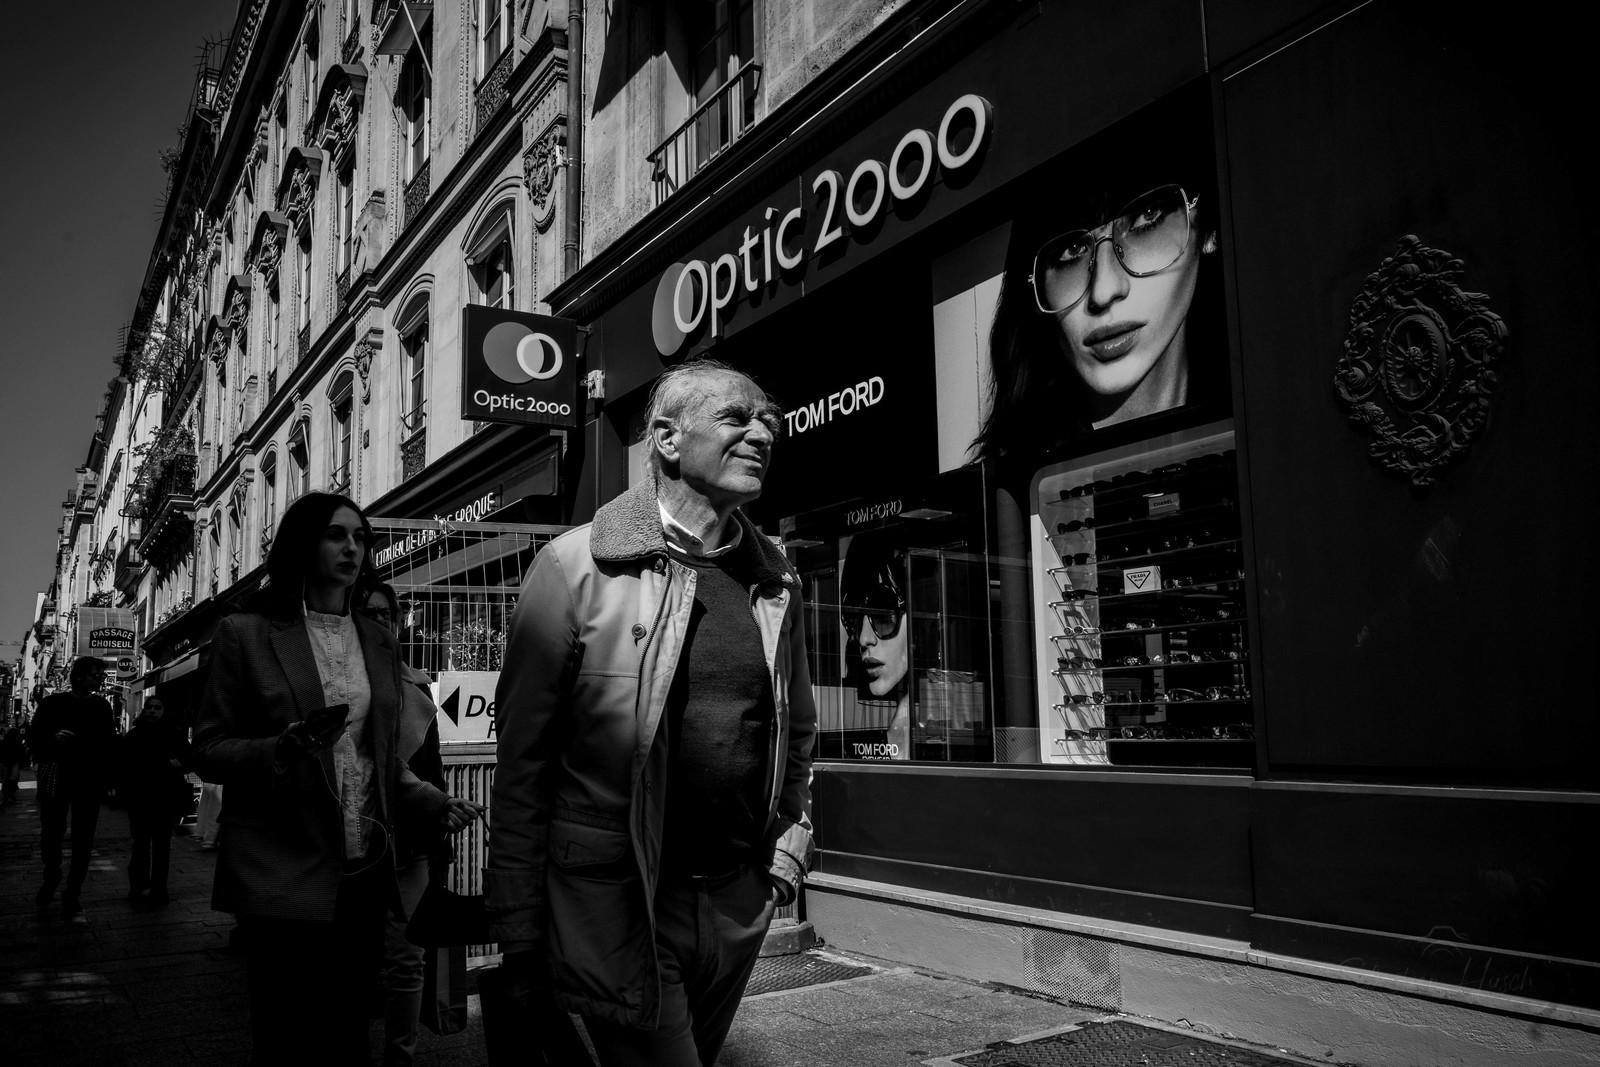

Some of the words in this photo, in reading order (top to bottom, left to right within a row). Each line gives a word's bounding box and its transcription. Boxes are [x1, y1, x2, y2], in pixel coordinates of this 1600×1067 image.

[674, 206, 807, 339] Optic
[812, 93, 992, 253] 2000
[474, 389, 525, 413] Optic
[527, 396, 572, 416] 2000
[784, 399, 825, 437] TOM
[828, 375, 885, 422] FORD
[847, 506, 869, 526] TOM
[870, 499, 902, 521] FORD
[1153, 498, 1173, 507] CHANEL
[91, 639, 133, 648] CHOISEUL
[92, 628, 134, 640] PASSAGE
[852, 743, 873, 756] TOM
[873, 743, 899, 756] FORD
